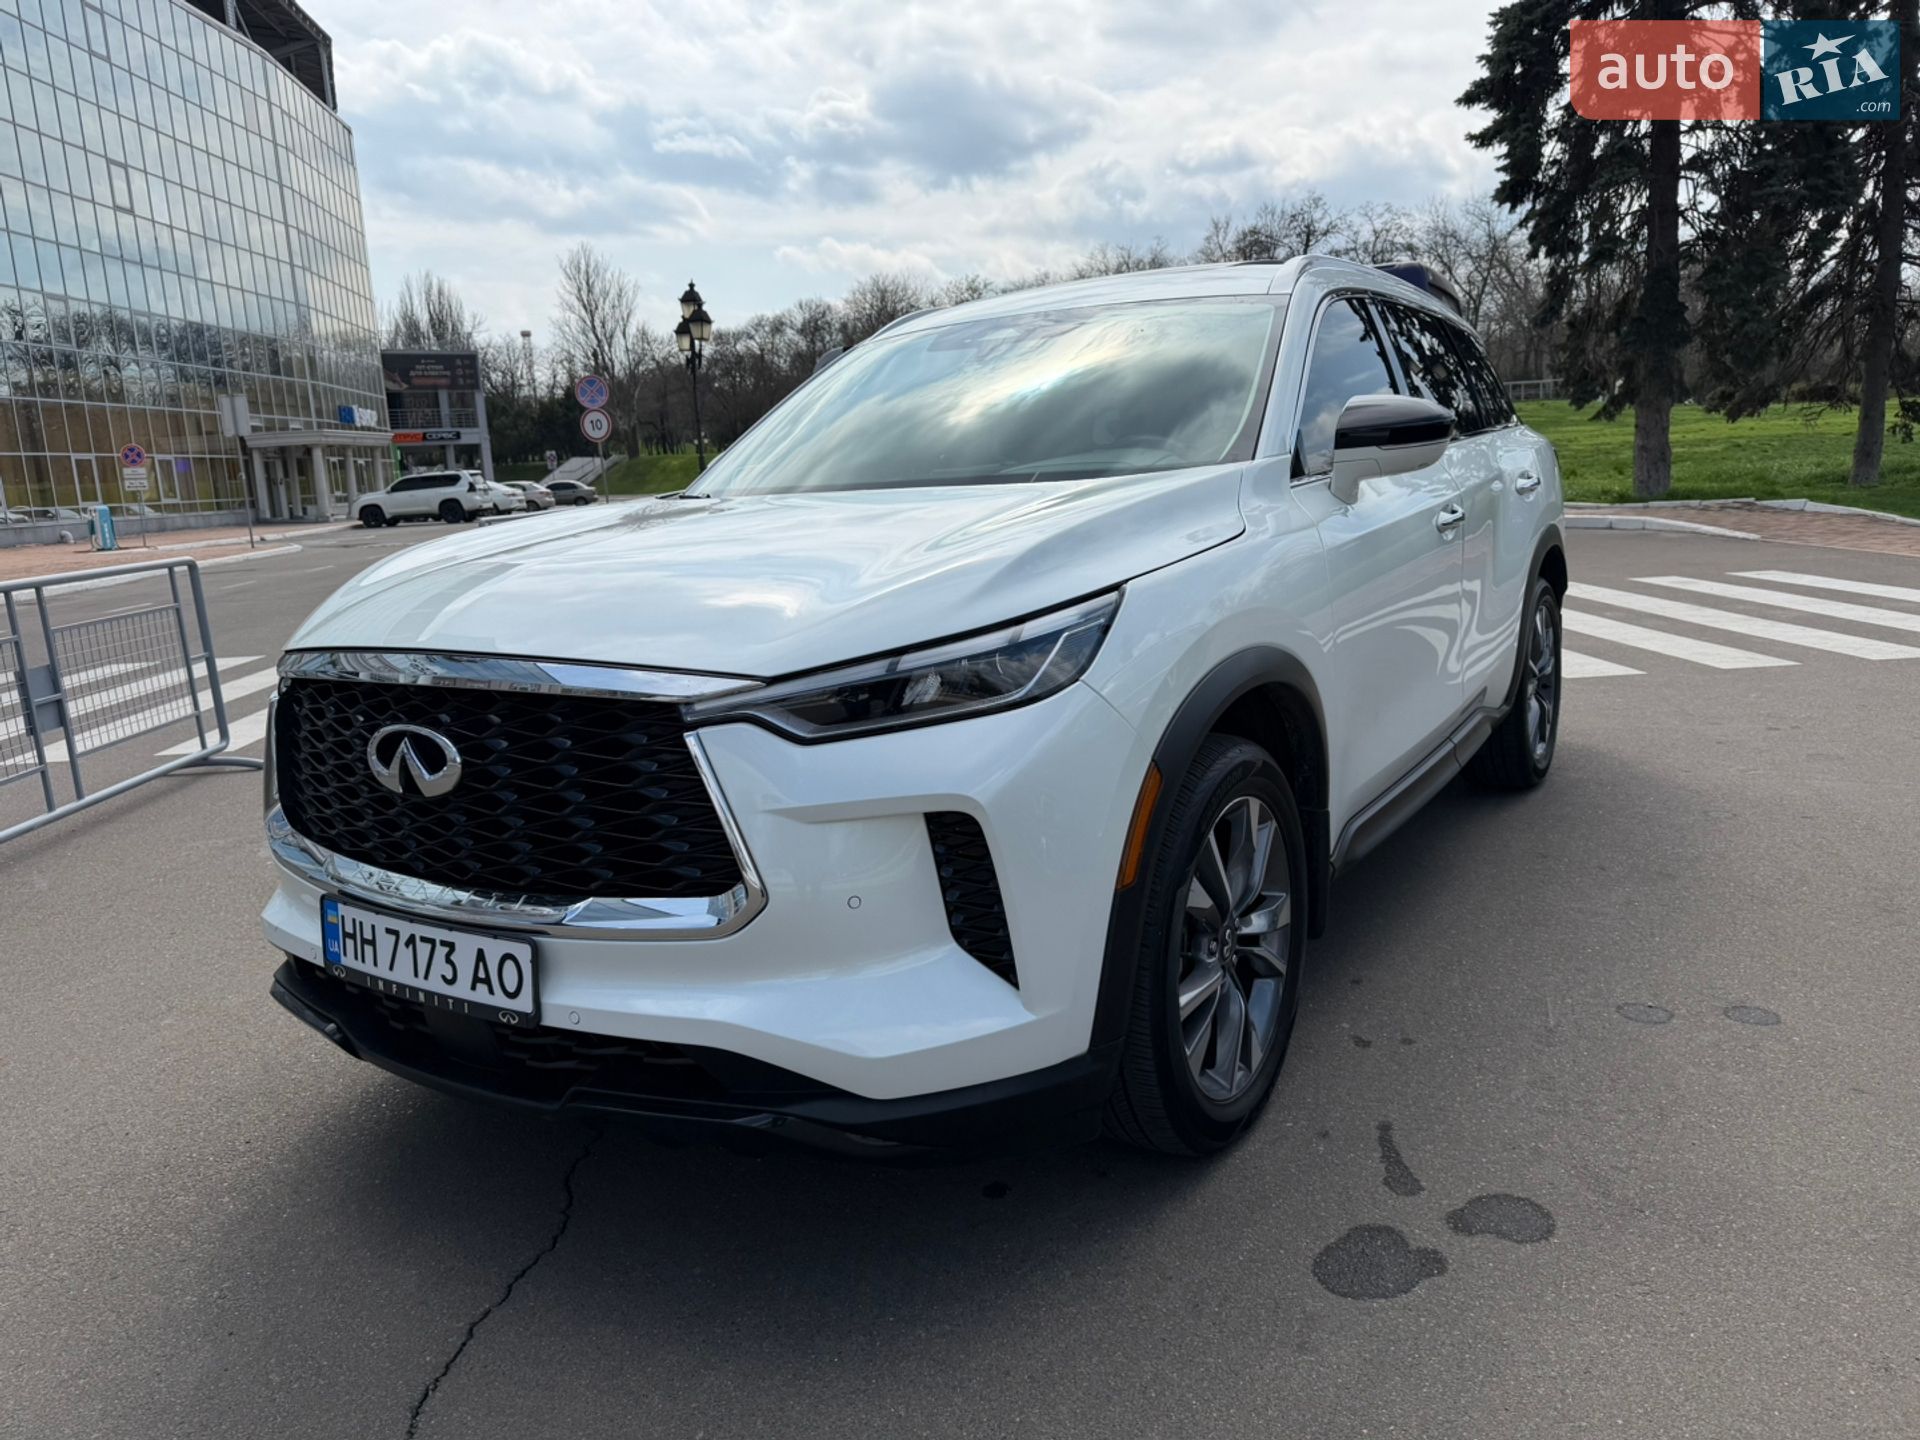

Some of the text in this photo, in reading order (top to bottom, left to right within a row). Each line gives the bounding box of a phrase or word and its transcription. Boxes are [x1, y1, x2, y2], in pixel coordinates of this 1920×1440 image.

[590, 418, 603, 432] 10
[329, 940, 340, 954] UA
[341, 914, 523, 999] HH 7173 AO
[367, 976, 469, 1013] INFINITI
